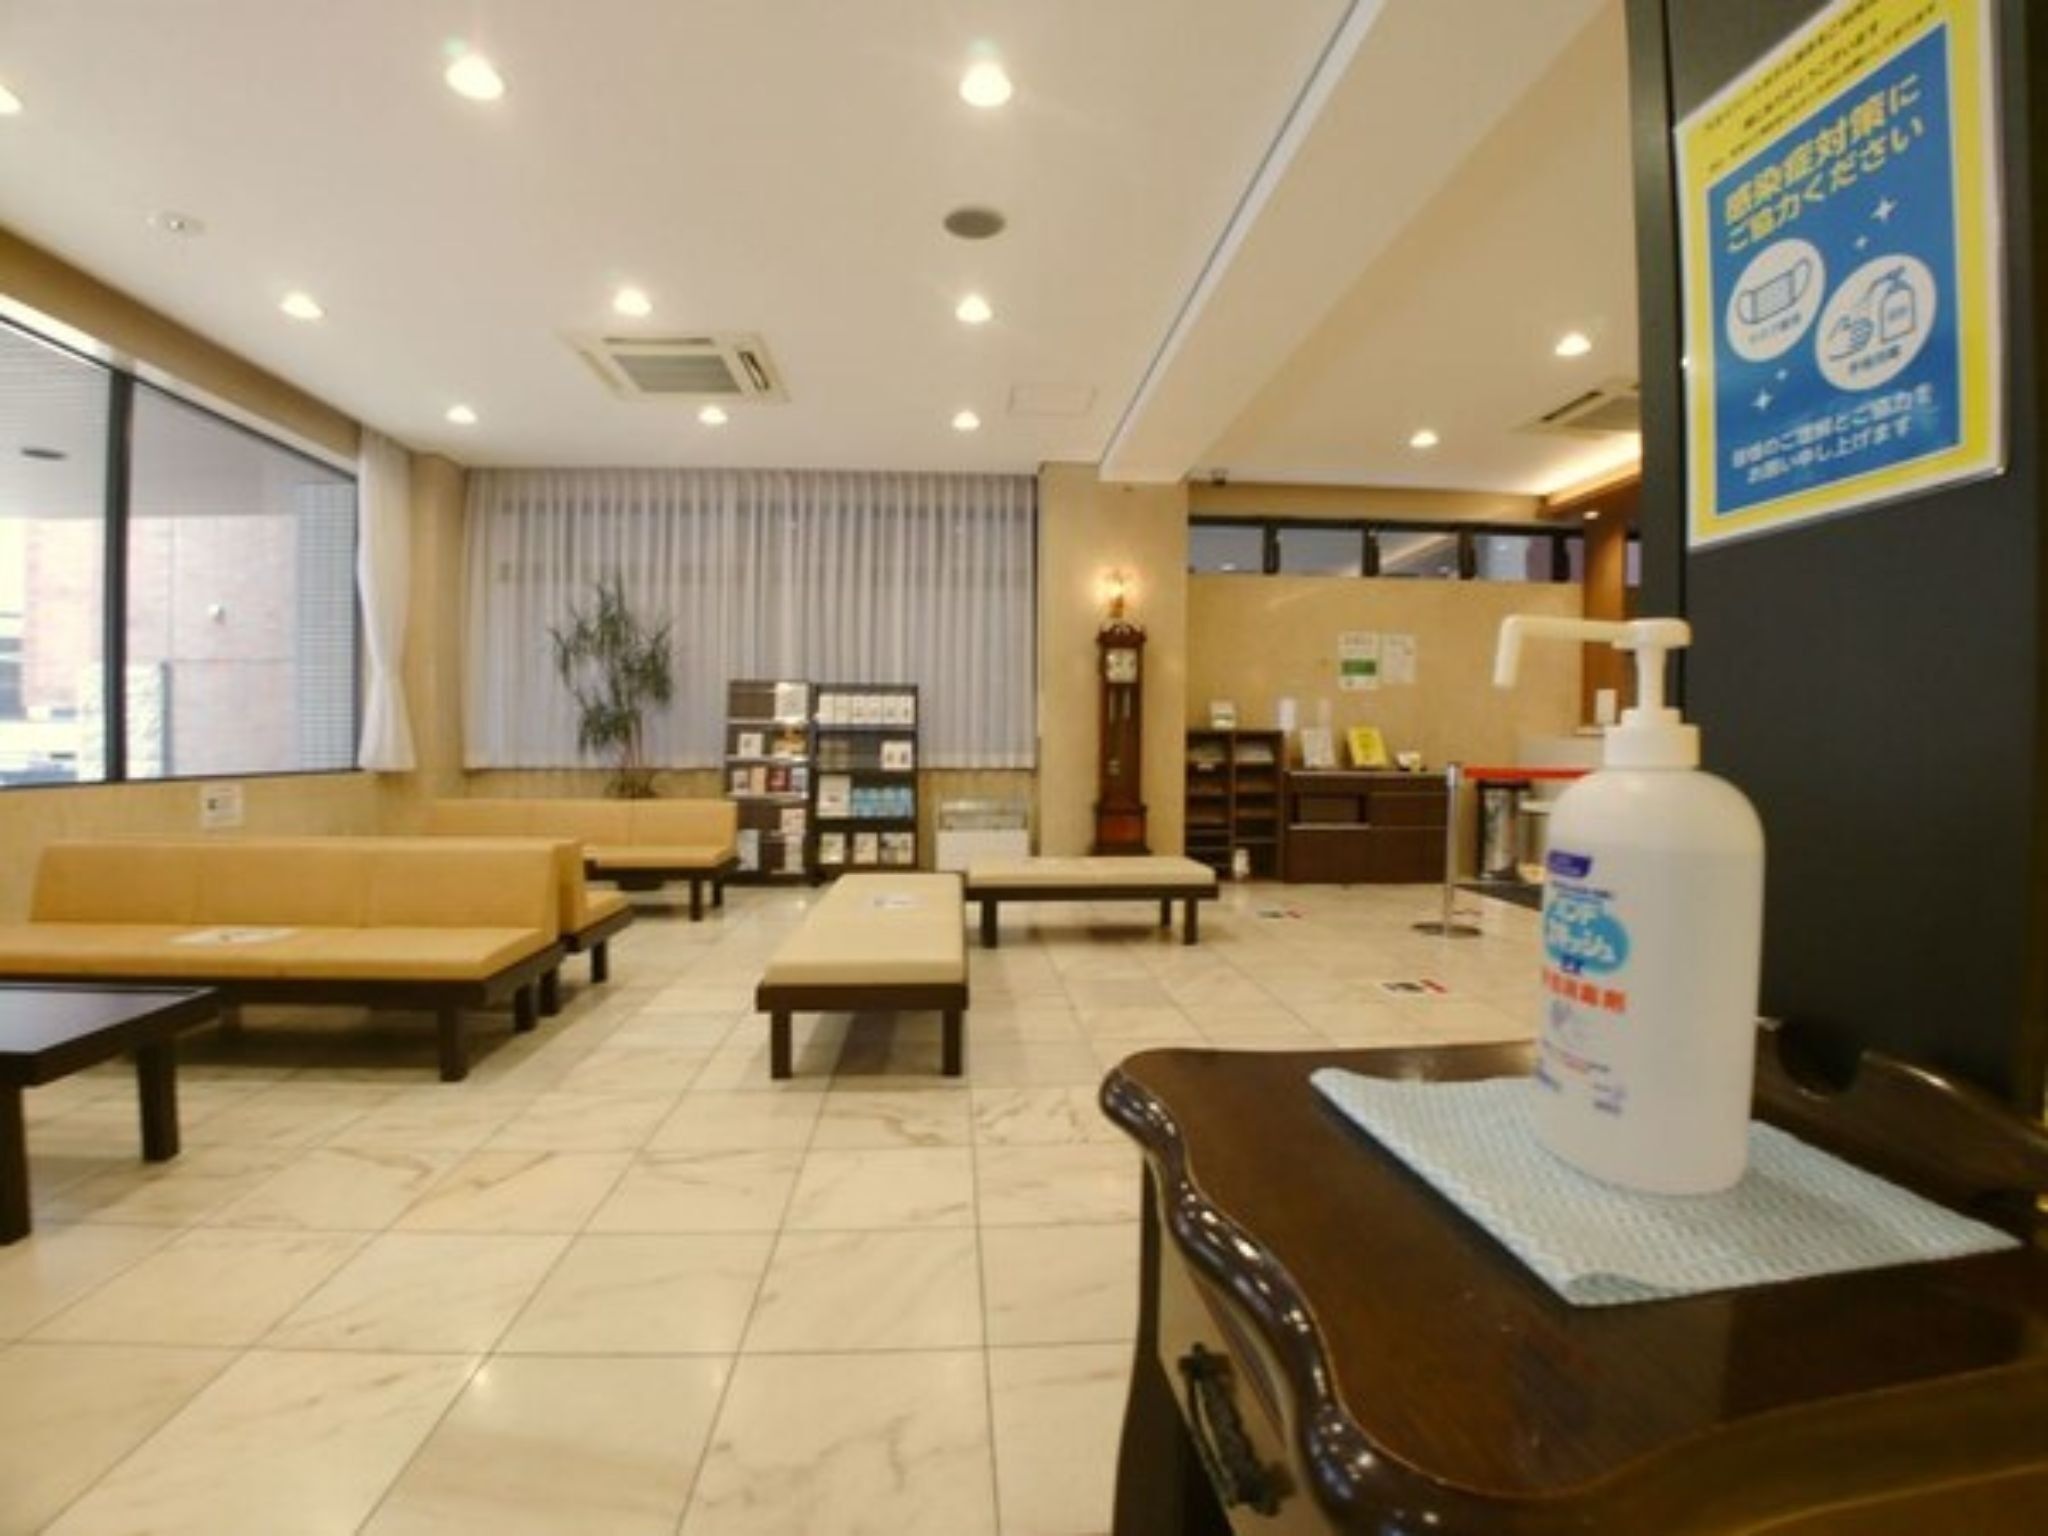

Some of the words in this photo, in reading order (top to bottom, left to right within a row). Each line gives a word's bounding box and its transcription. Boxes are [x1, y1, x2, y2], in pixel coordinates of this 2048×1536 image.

[1726, 74, 1921, 226] 感染症対策に
[1727, 116, 1924, 253] ご協力ください
